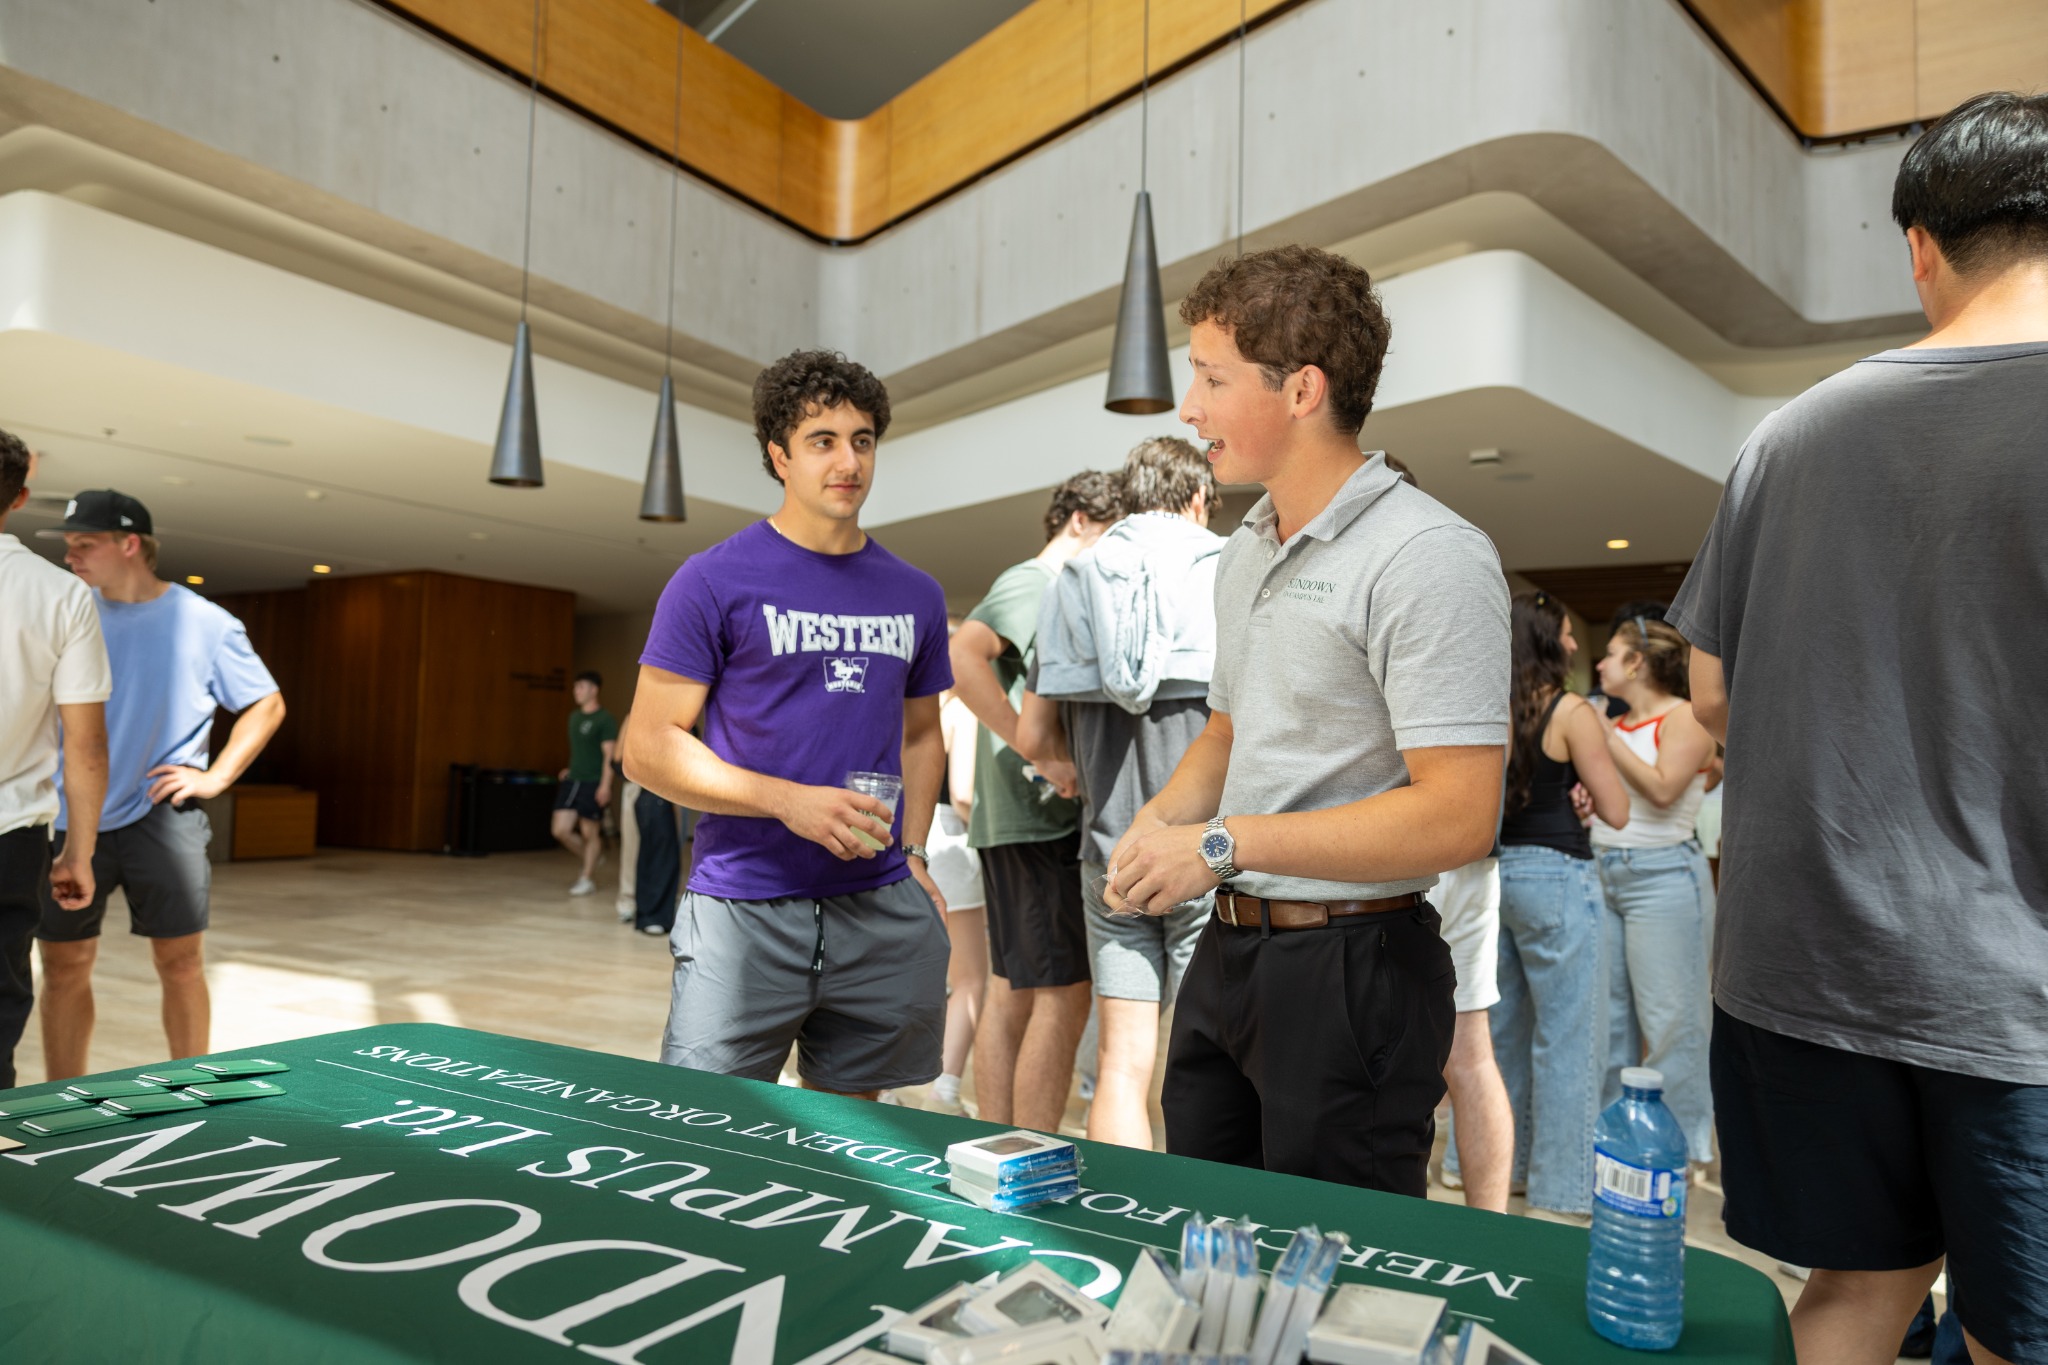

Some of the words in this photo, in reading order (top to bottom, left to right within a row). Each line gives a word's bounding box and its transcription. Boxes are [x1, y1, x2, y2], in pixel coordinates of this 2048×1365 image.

[762, 603, 915, 664] WESTERN
[353, 1045, 732, 1126] ORGANIZATIONS
[340, 1099, 553, 1157] Ltd.
[725, 1121, 951, 1180] UDENT
